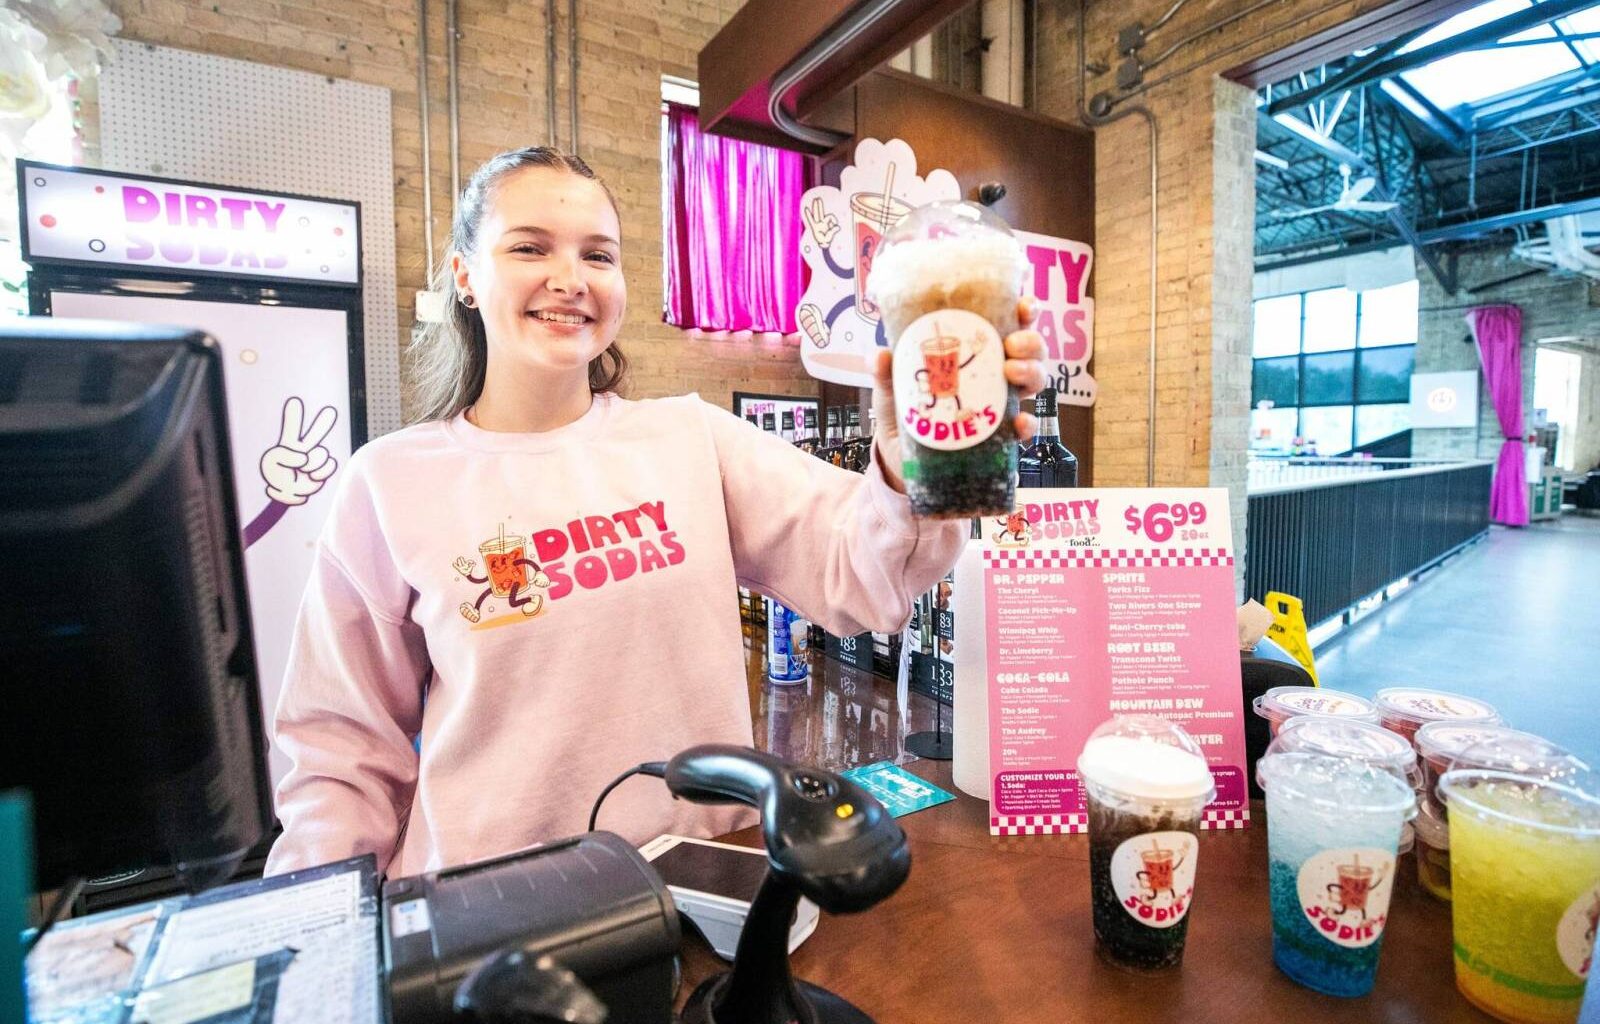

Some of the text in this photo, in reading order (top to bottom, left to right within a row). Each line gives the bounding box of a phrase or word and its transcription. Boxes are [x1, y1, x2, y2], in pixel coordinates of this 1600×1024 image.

[122, 186, 286, 233] DIRTY
[905, 405, 998, 441] SODIE'S
[1025, 499, 1099, 523] DIRTY
[532, 501, 668, 563] DIRTY
[1031, 517, 1101, 541] SODAS
[542, 531, 686, 600] SODAS
[993, 573, 1065, 585] DR. PEPPER
[1103, 572, 1145, 583] SPRITE
[998, 607, 1030, 615] Coconut
[999, 627, 1036, 635] Winnipeg
[1107, 642, 1175, 653] ROOT BEER
[996, 672, 1070, 684] COCA-COLA
[1148, 676, 1175, 684] Punch
[1109, 698, 1204, 710] MOUNTAIN DEW
[1195, 710, 1234, 718] Premium
[1000, 774, 1043, 782] CUSTOMIZE
[1044, 773, 1065, 781] YOUR
